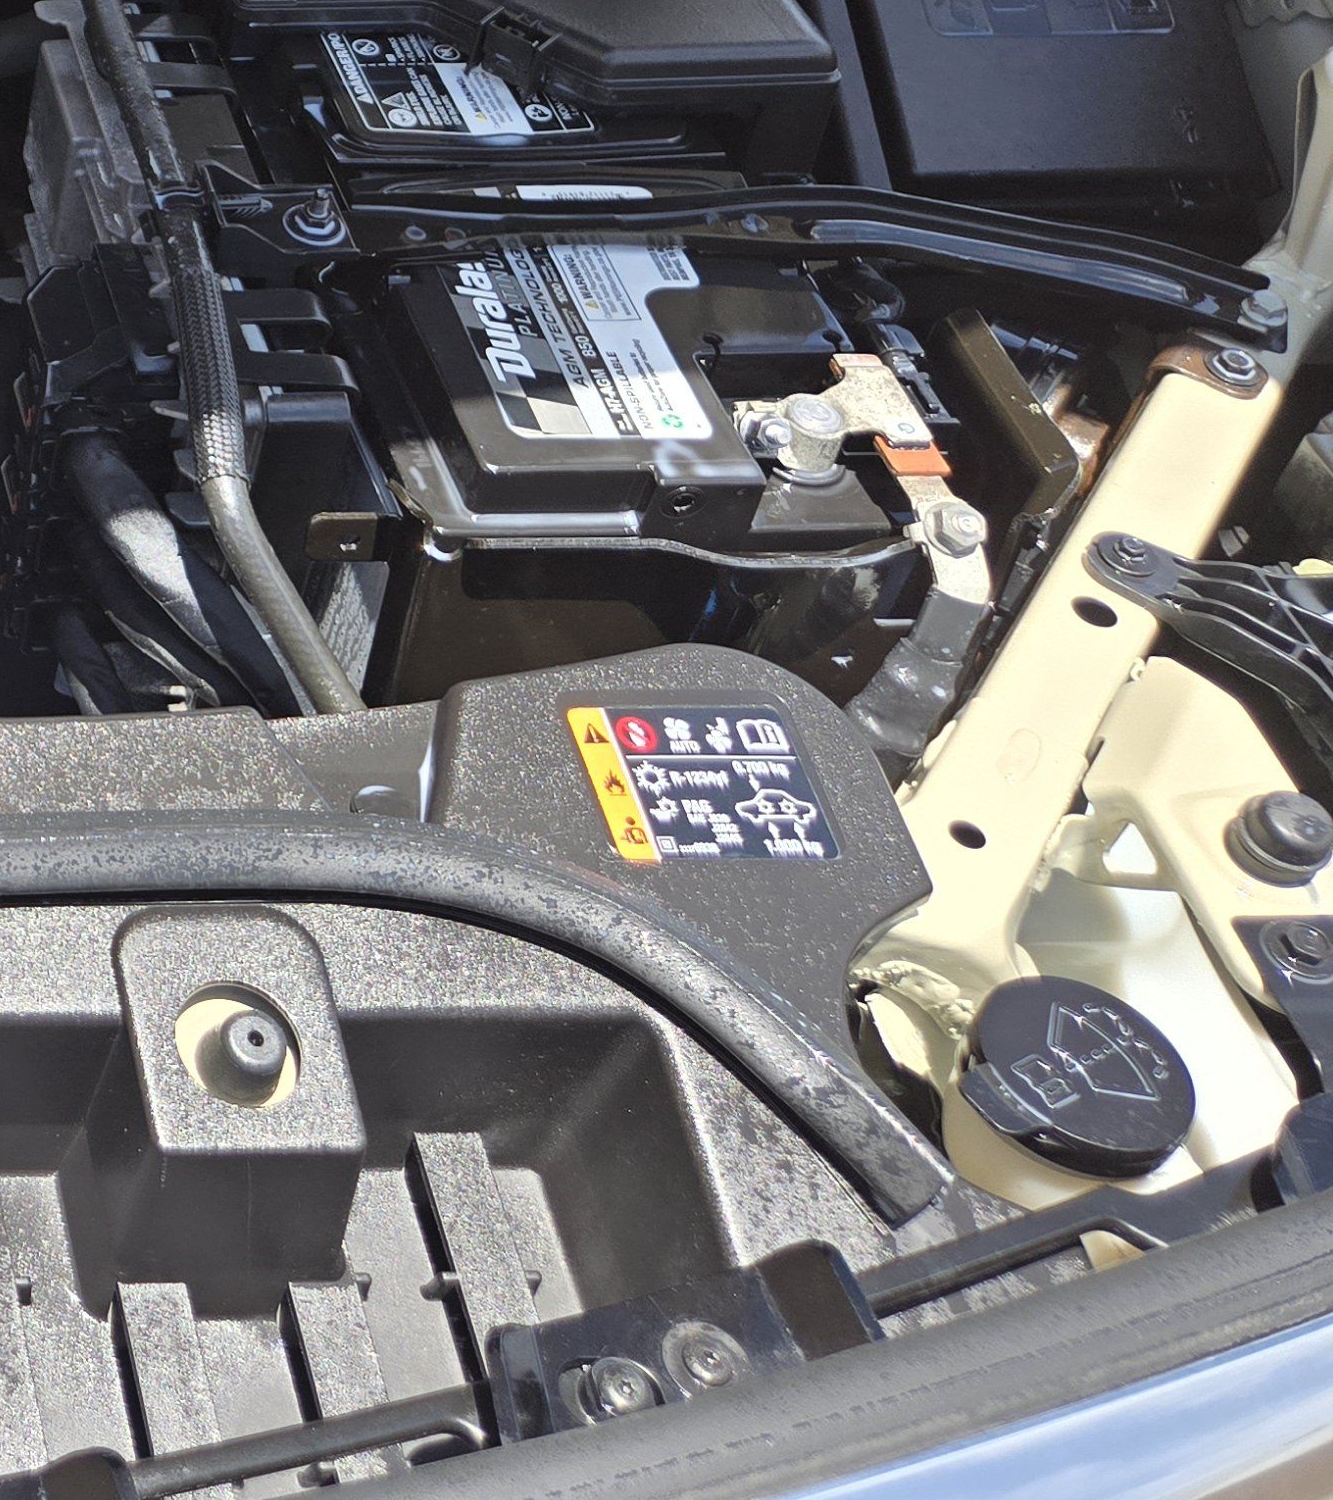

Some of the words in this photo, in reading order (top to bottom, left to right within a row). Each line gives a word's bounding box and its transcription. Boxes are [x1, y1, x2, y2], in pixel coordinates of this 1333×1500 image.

[563, 254, 593, 300] WARNING:
[575, 335, 595, 358] 850
[558, 347, 590, 389] AGM
[606, 351, 653, 430] NON-SPILLABLE
[681, 799, 714, 814] PAG
